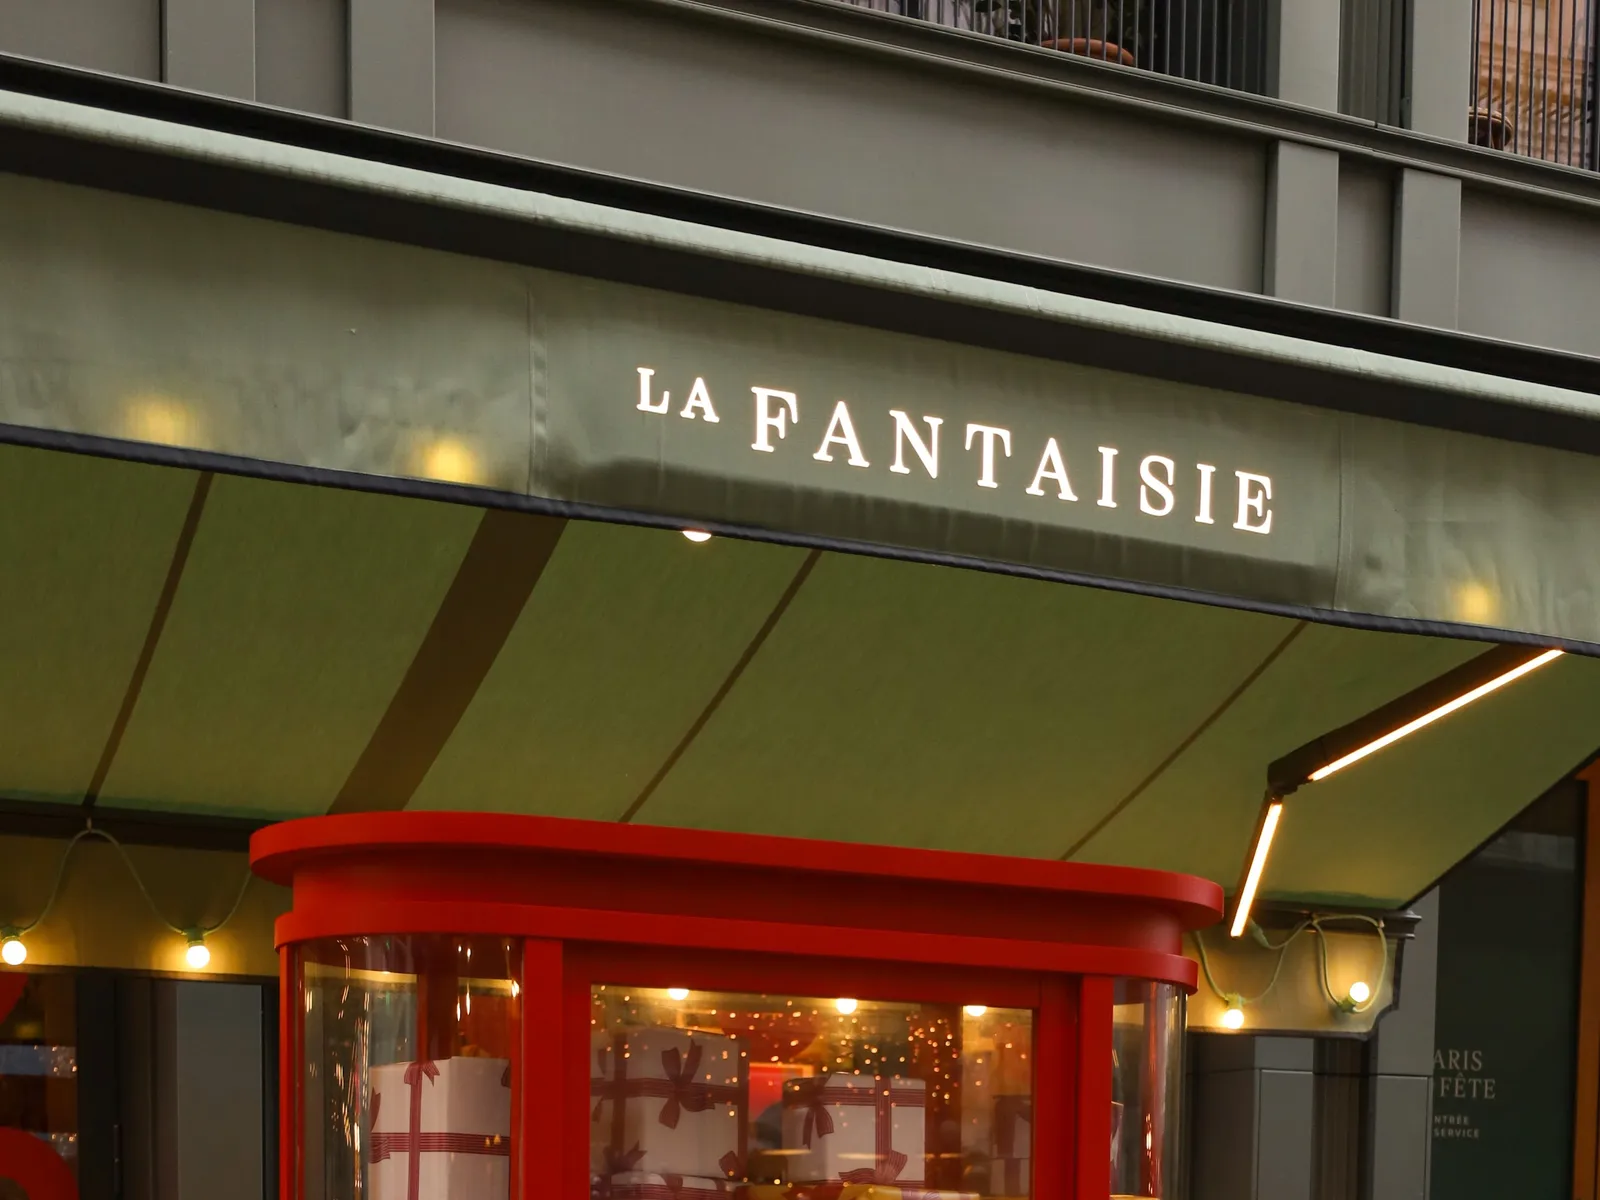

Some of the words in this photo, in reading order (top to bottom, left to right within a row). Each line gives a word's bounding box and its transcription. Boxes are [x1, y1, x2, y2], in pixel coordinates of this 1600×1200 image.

[635, 366, 721, 424] LA
[750, 385, 1274, 536] FANTAISIE
[1433, 1048, 1483, 1072] ARIS
[1440, 1072, 1496, 1099] FÊTE
[1434, 1113, 1470, 1126] NTRÉE
